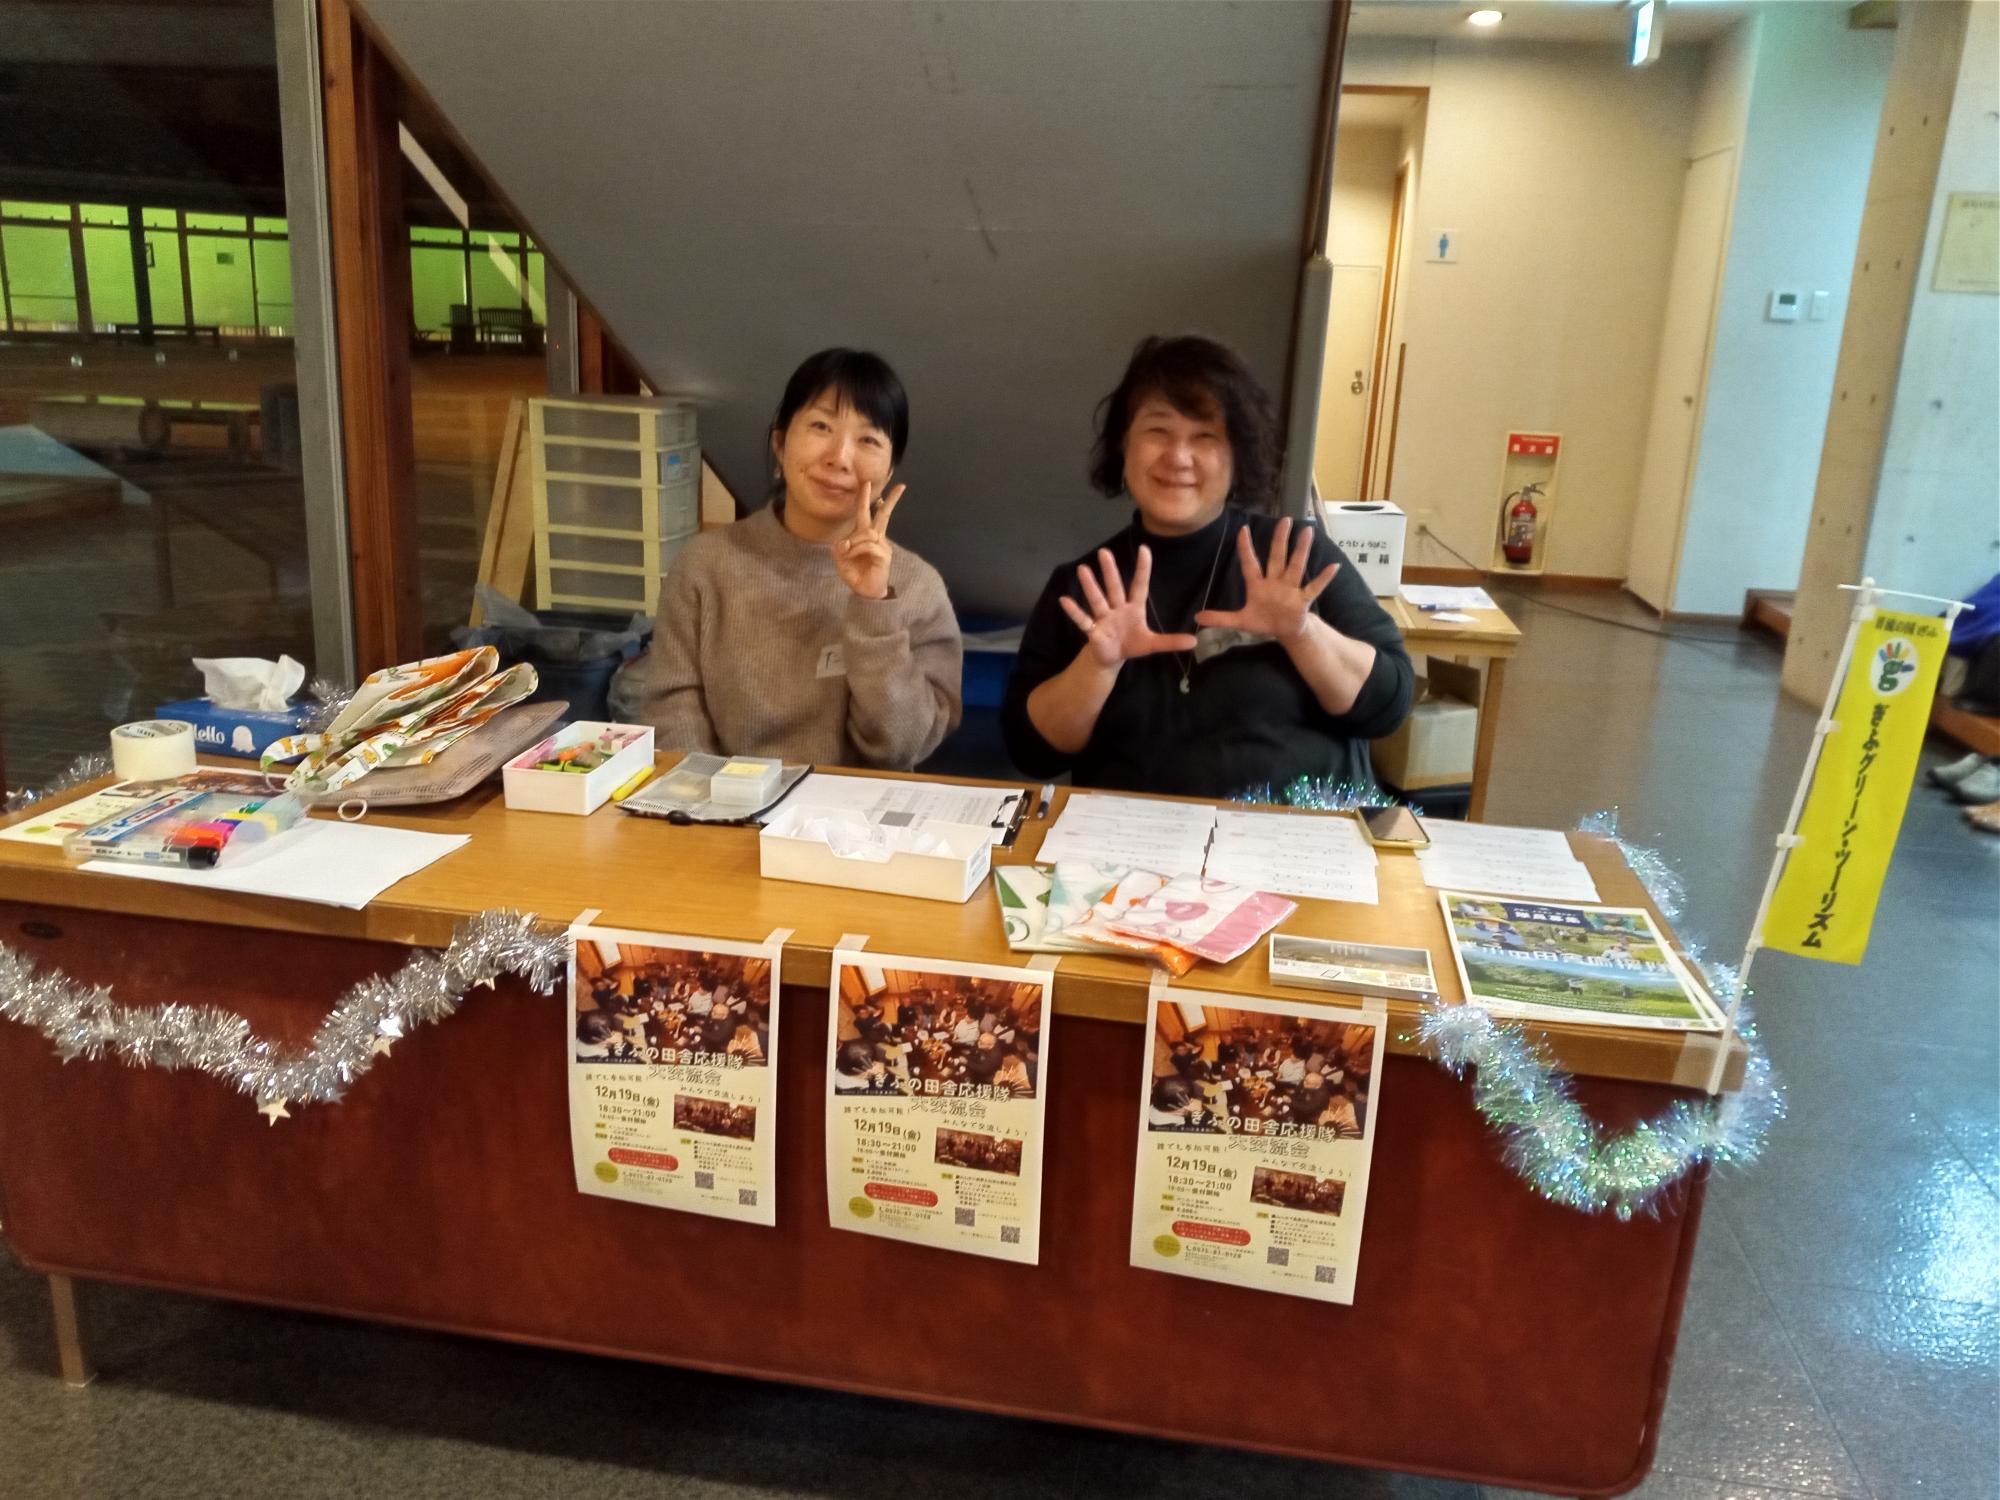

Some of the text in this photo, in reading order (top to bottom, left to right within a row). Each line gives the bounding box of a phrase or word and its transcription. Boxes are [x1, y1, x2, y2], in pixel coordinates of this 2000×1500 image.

[874, 1072, 1011, 1102] ぎふの田舎応援隊
[1191, 1110, 1337, 1143] ぎふの田舎応援隊
[1166, 1156, 1238, 1180] 12月19日(金)
